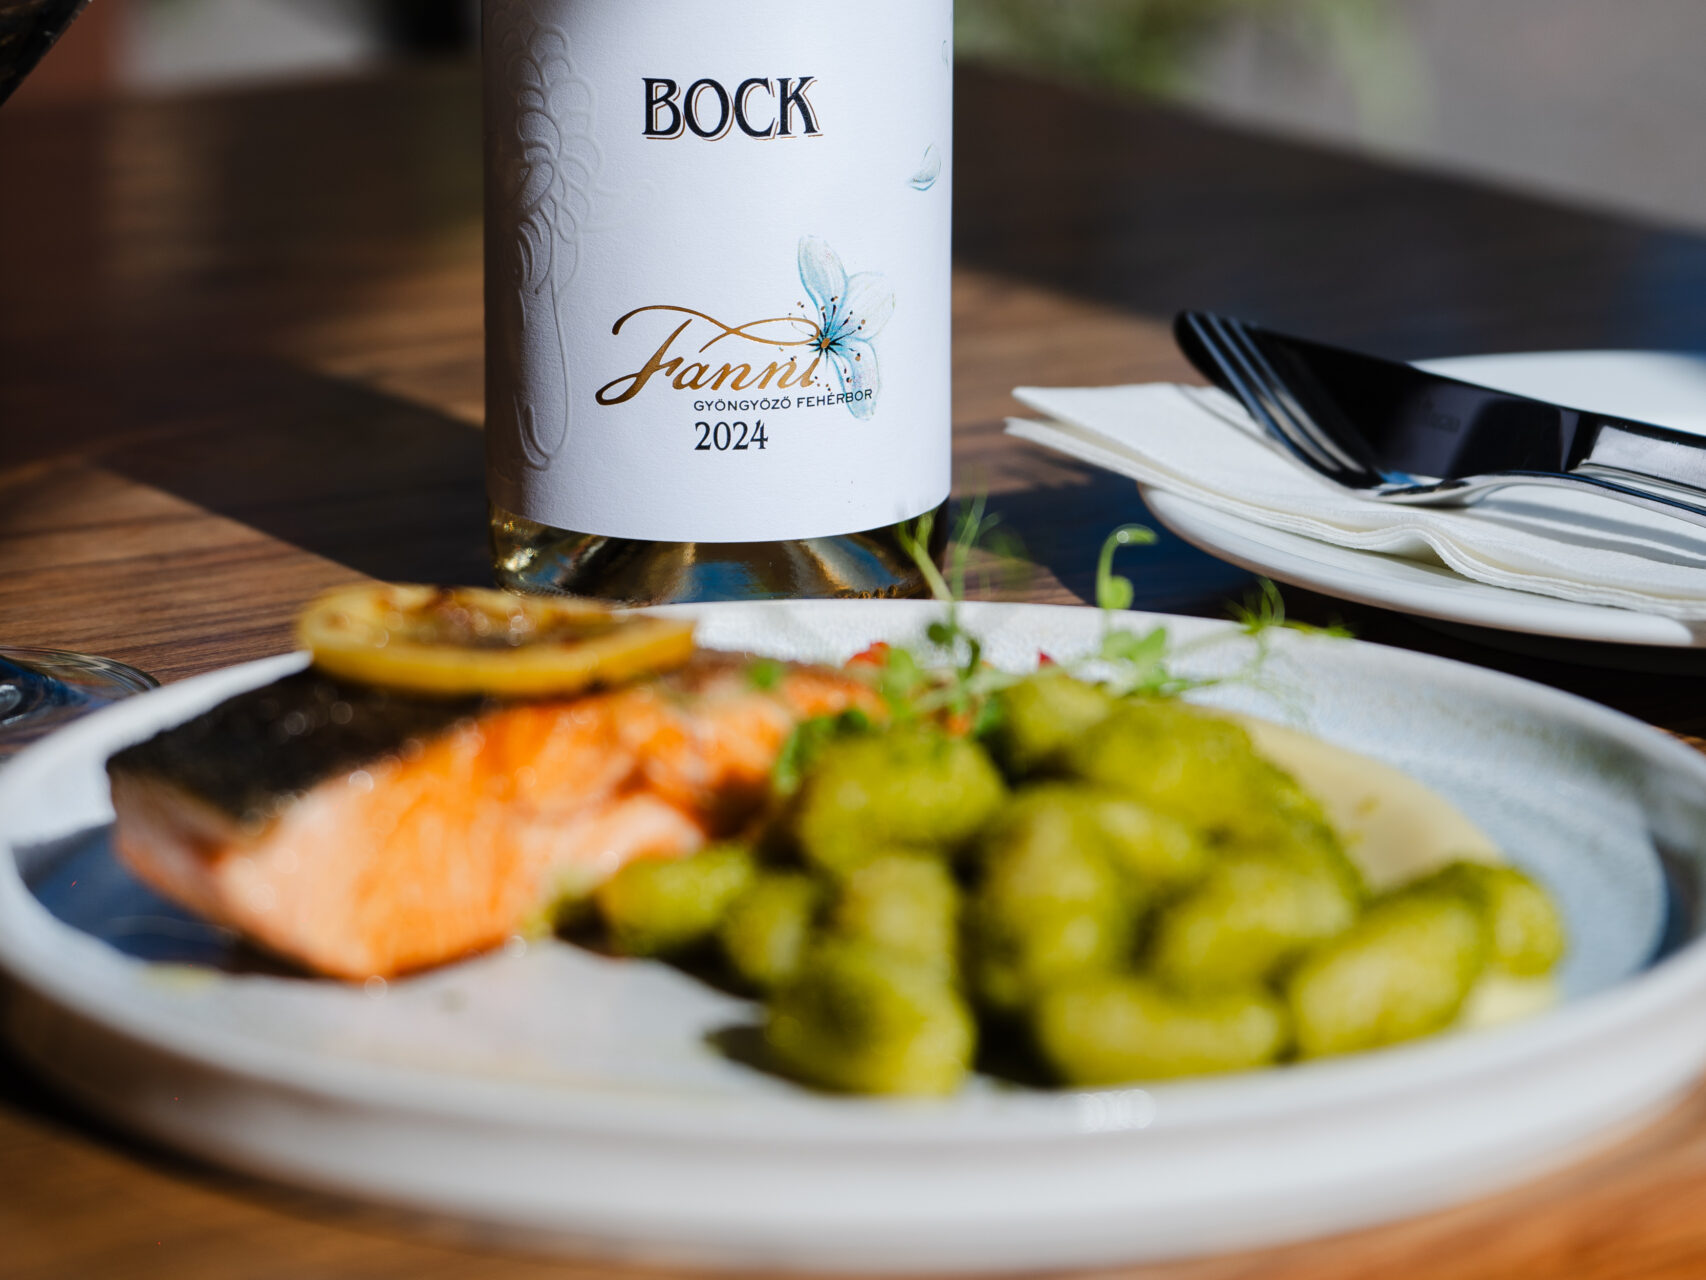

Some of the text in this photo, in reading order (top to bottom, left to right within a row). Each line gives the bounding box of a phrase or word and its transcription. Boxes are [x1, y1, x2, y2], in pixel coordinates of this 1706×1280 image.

[641, 76, 824, 141] BOCK
[595, 304, 821, 406] Fanni
[693, 388, 874, 412] GYÖNGYÖZŐ FEHÉRBOR
[694, 419, 769, 451] 2024
